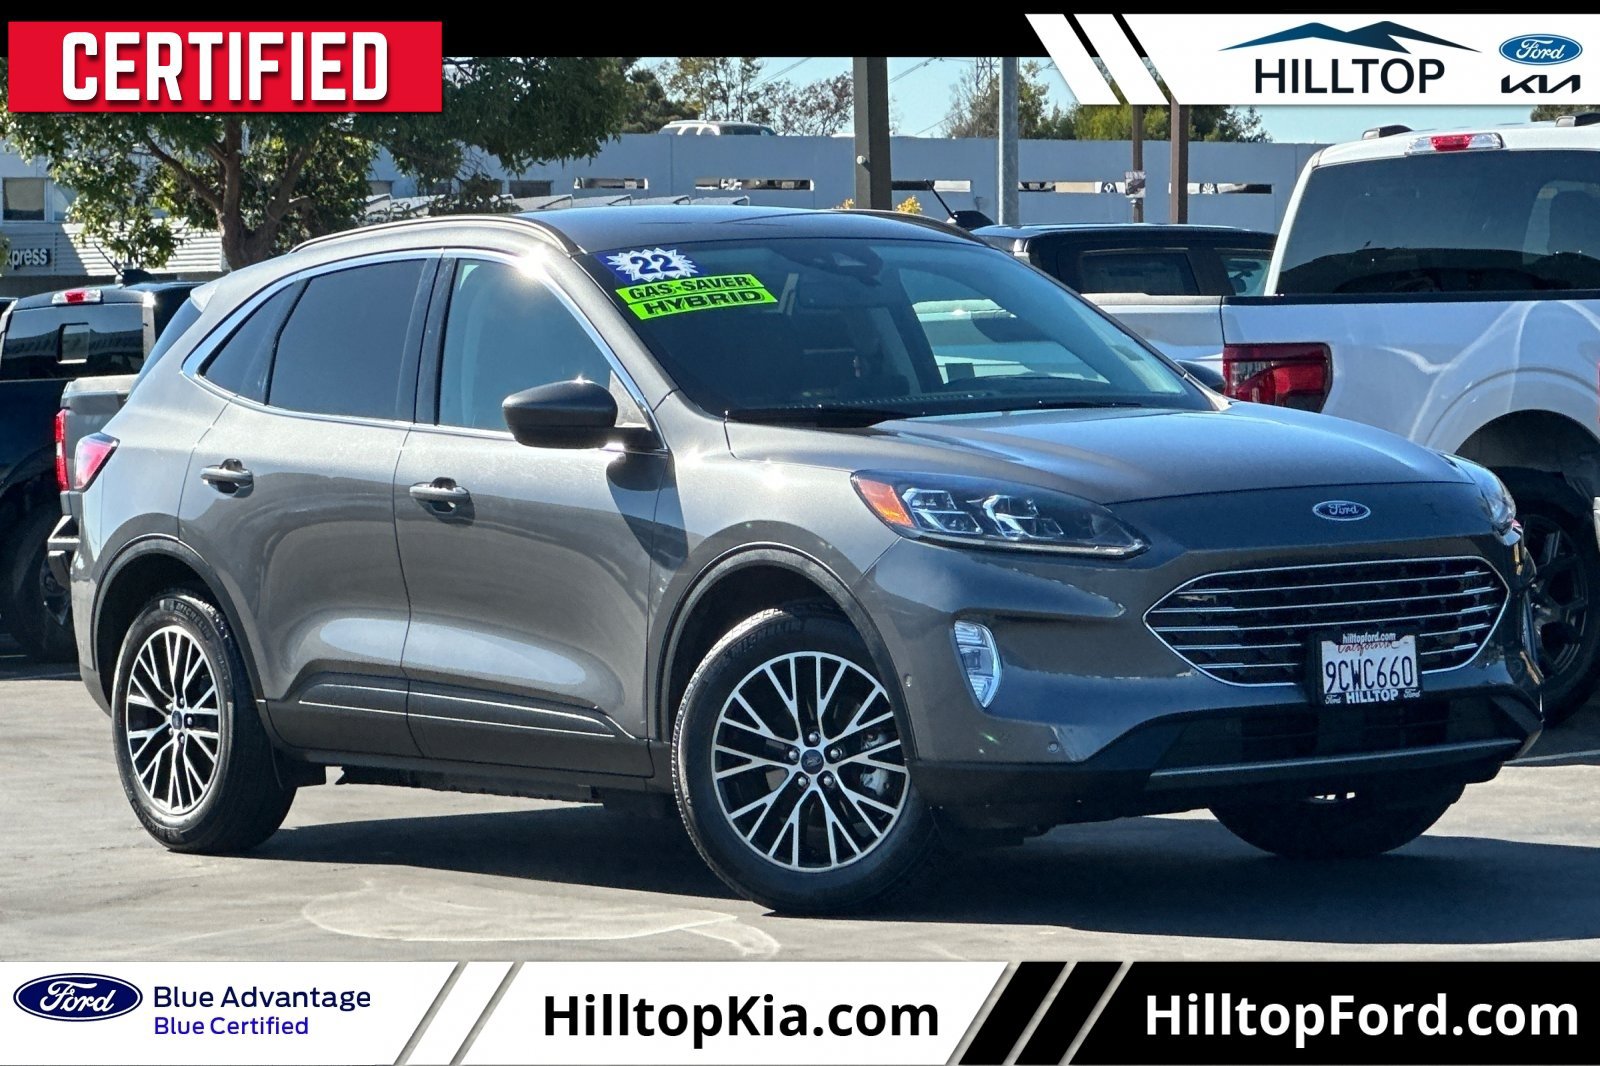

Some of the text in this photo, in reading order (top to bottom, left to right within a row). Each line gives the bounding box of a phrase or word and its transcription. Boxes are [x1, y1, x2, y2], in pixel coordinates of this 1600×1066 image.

[4, 247, 48, 270] xpress
[629, 254, 681, 275] 22
[628, 275, 755, 301] GAS-SAVER
[643, 289, 767, 315] HYBRID
[1342, 631, 1396, 644] hilltopford.com
[1325, 656, 1413, 693] 9CWC660
[1345, 688, 1399, 704] HILLTOP
[1403, 688, 1421, 699] Ford
